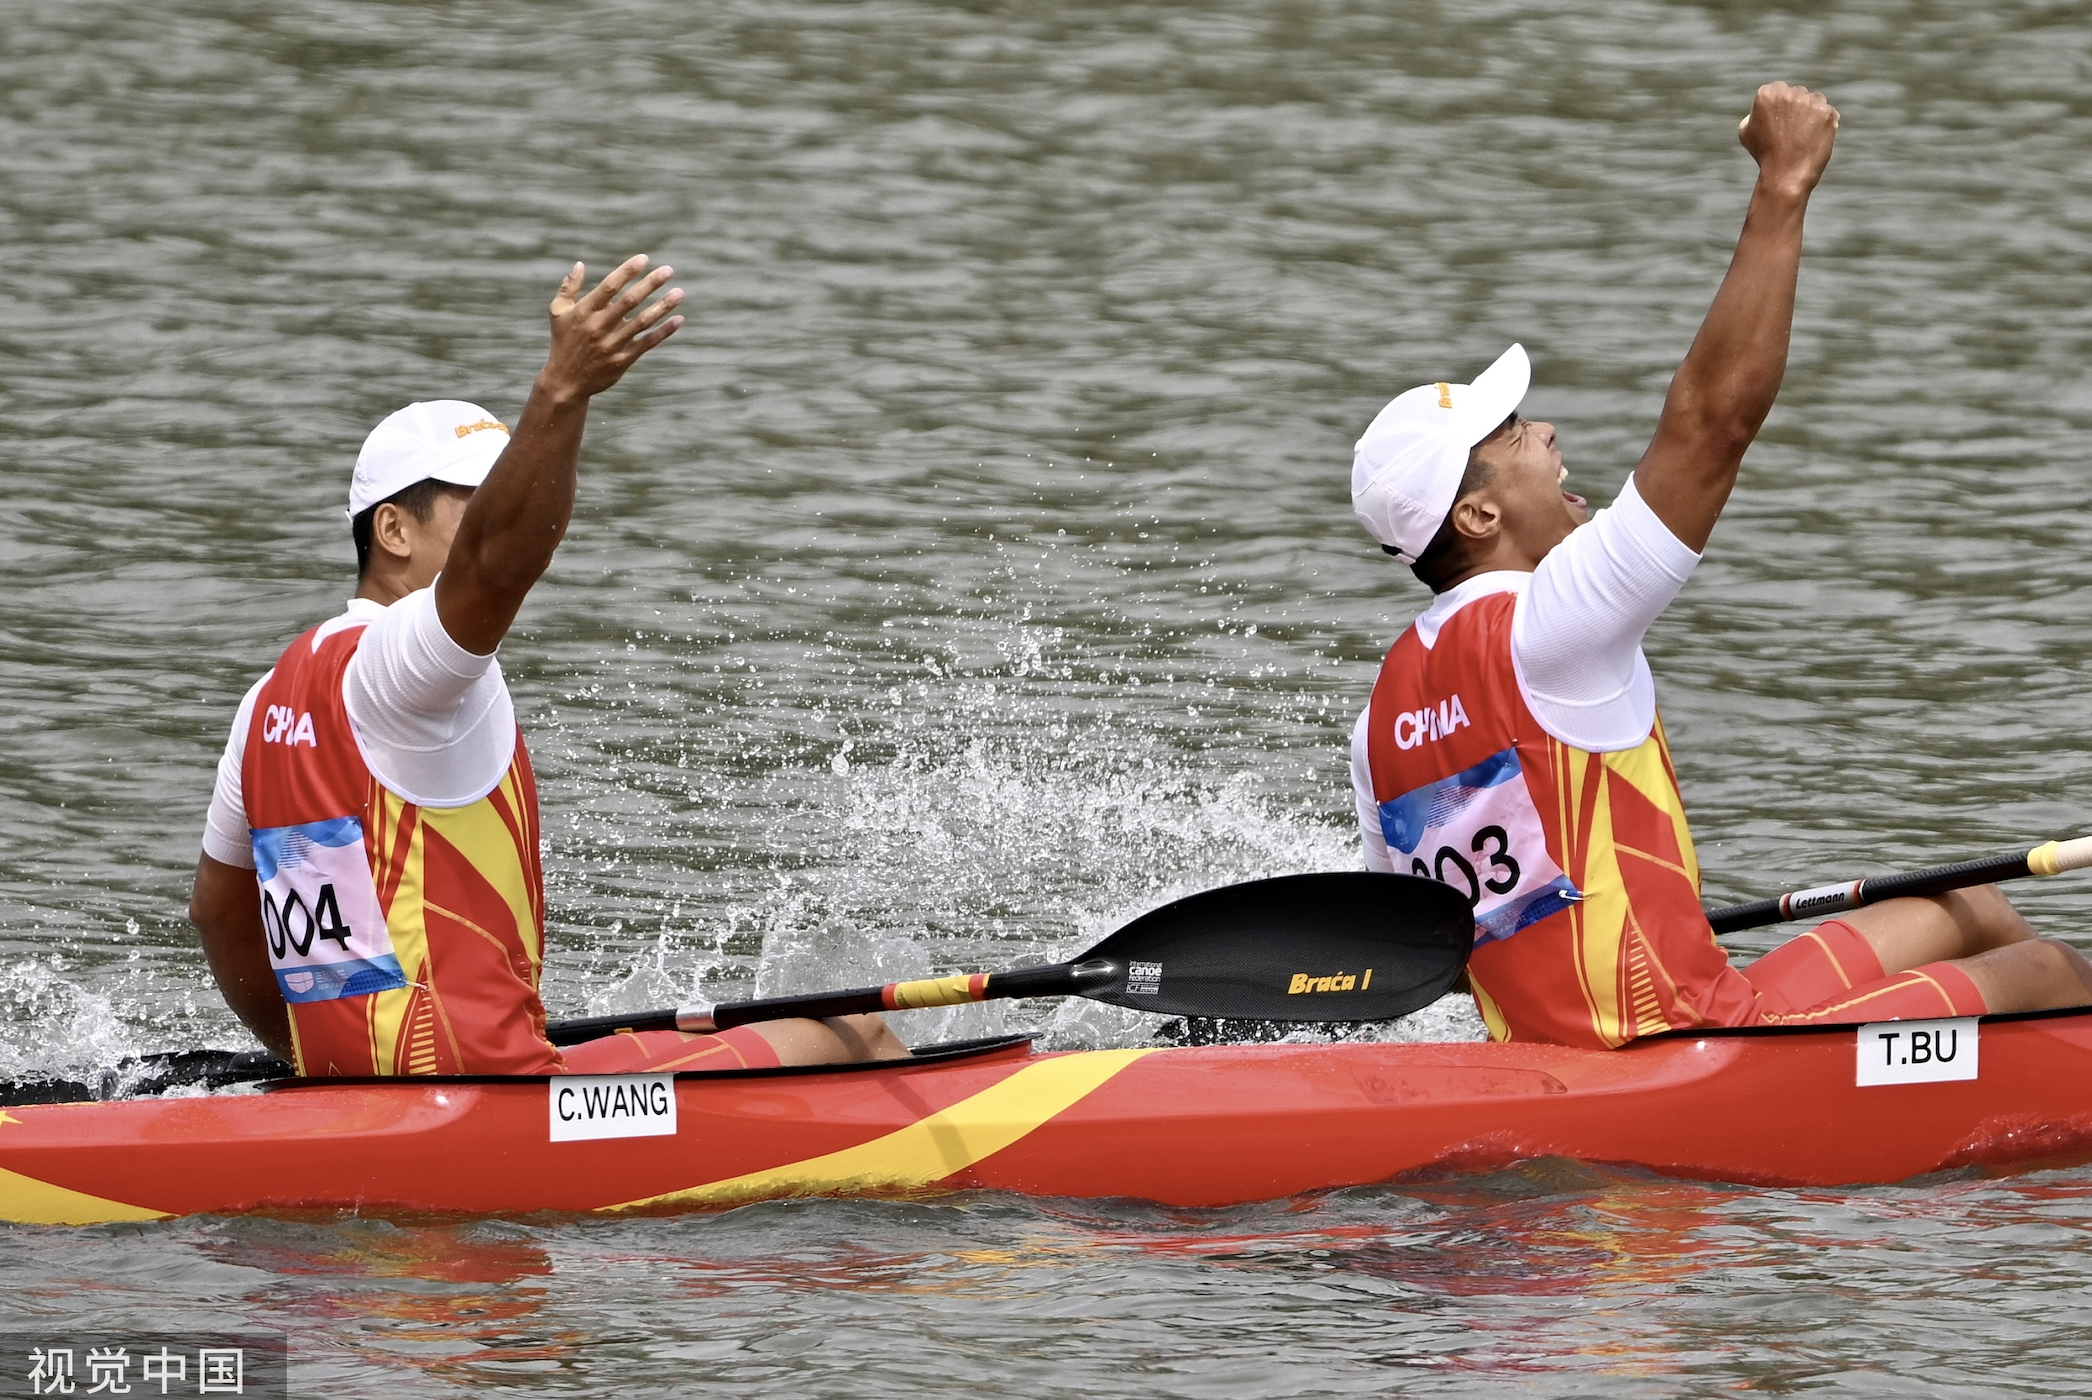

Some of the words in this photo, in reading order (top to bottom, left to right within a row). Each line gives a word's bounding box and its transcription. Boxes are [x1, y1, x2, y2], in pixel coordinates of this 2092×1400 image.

[1795, 892, 1845, 909] Lettmann
[264, 883, 352, 960] 004
[1129, 966, 1162, 976] canoe
[1288, 970, 1356, 994] Braća
[1878, 1029, 1957, 1065] T.BU
[558, 1082, 668, 1121] C.WANG
